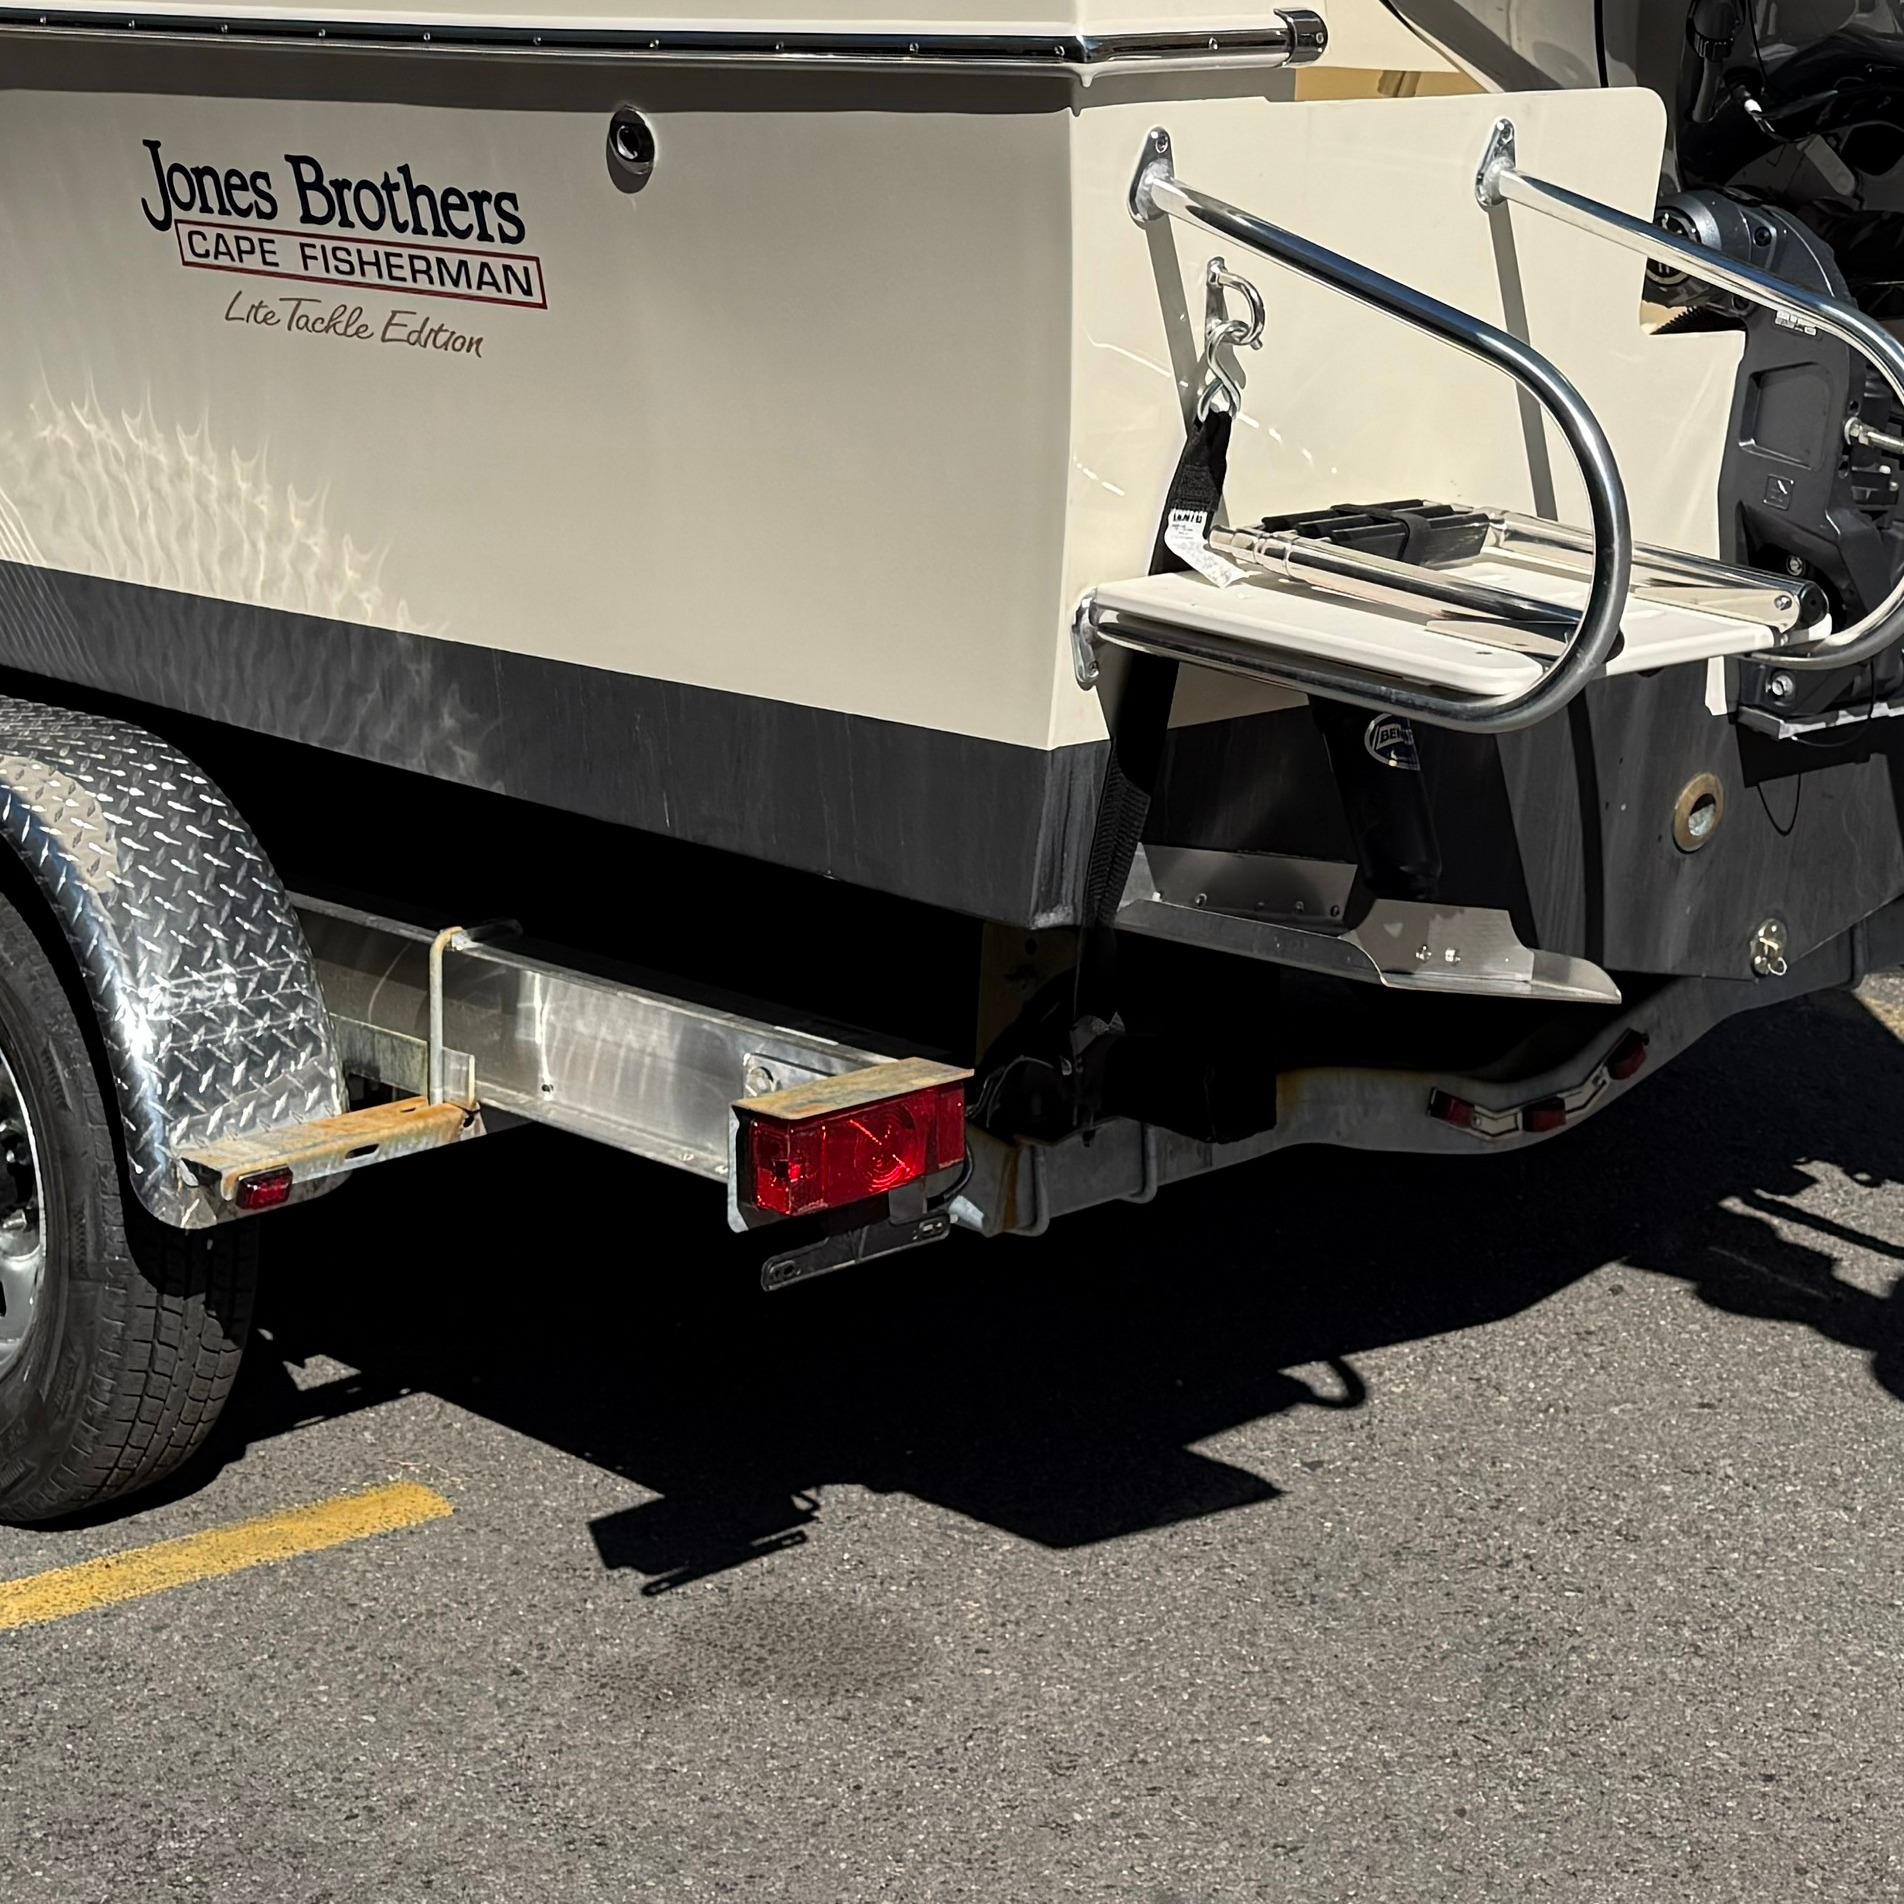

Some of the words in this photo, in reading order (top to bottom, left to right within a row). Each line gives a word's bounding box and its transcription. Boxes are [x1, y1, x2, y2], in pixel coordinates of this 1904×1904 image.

[141, 138, 278, 233] Jones
[284, 153, 527, 246] Brothers
[186, 228, 281, 269] CAPE
[299, 240, 534, 298] FISHERMAN
[223, 290, 282, 328] Lite
[279, 296, 375, 340] Tackle
[380, 309, 484, 359] Edition
